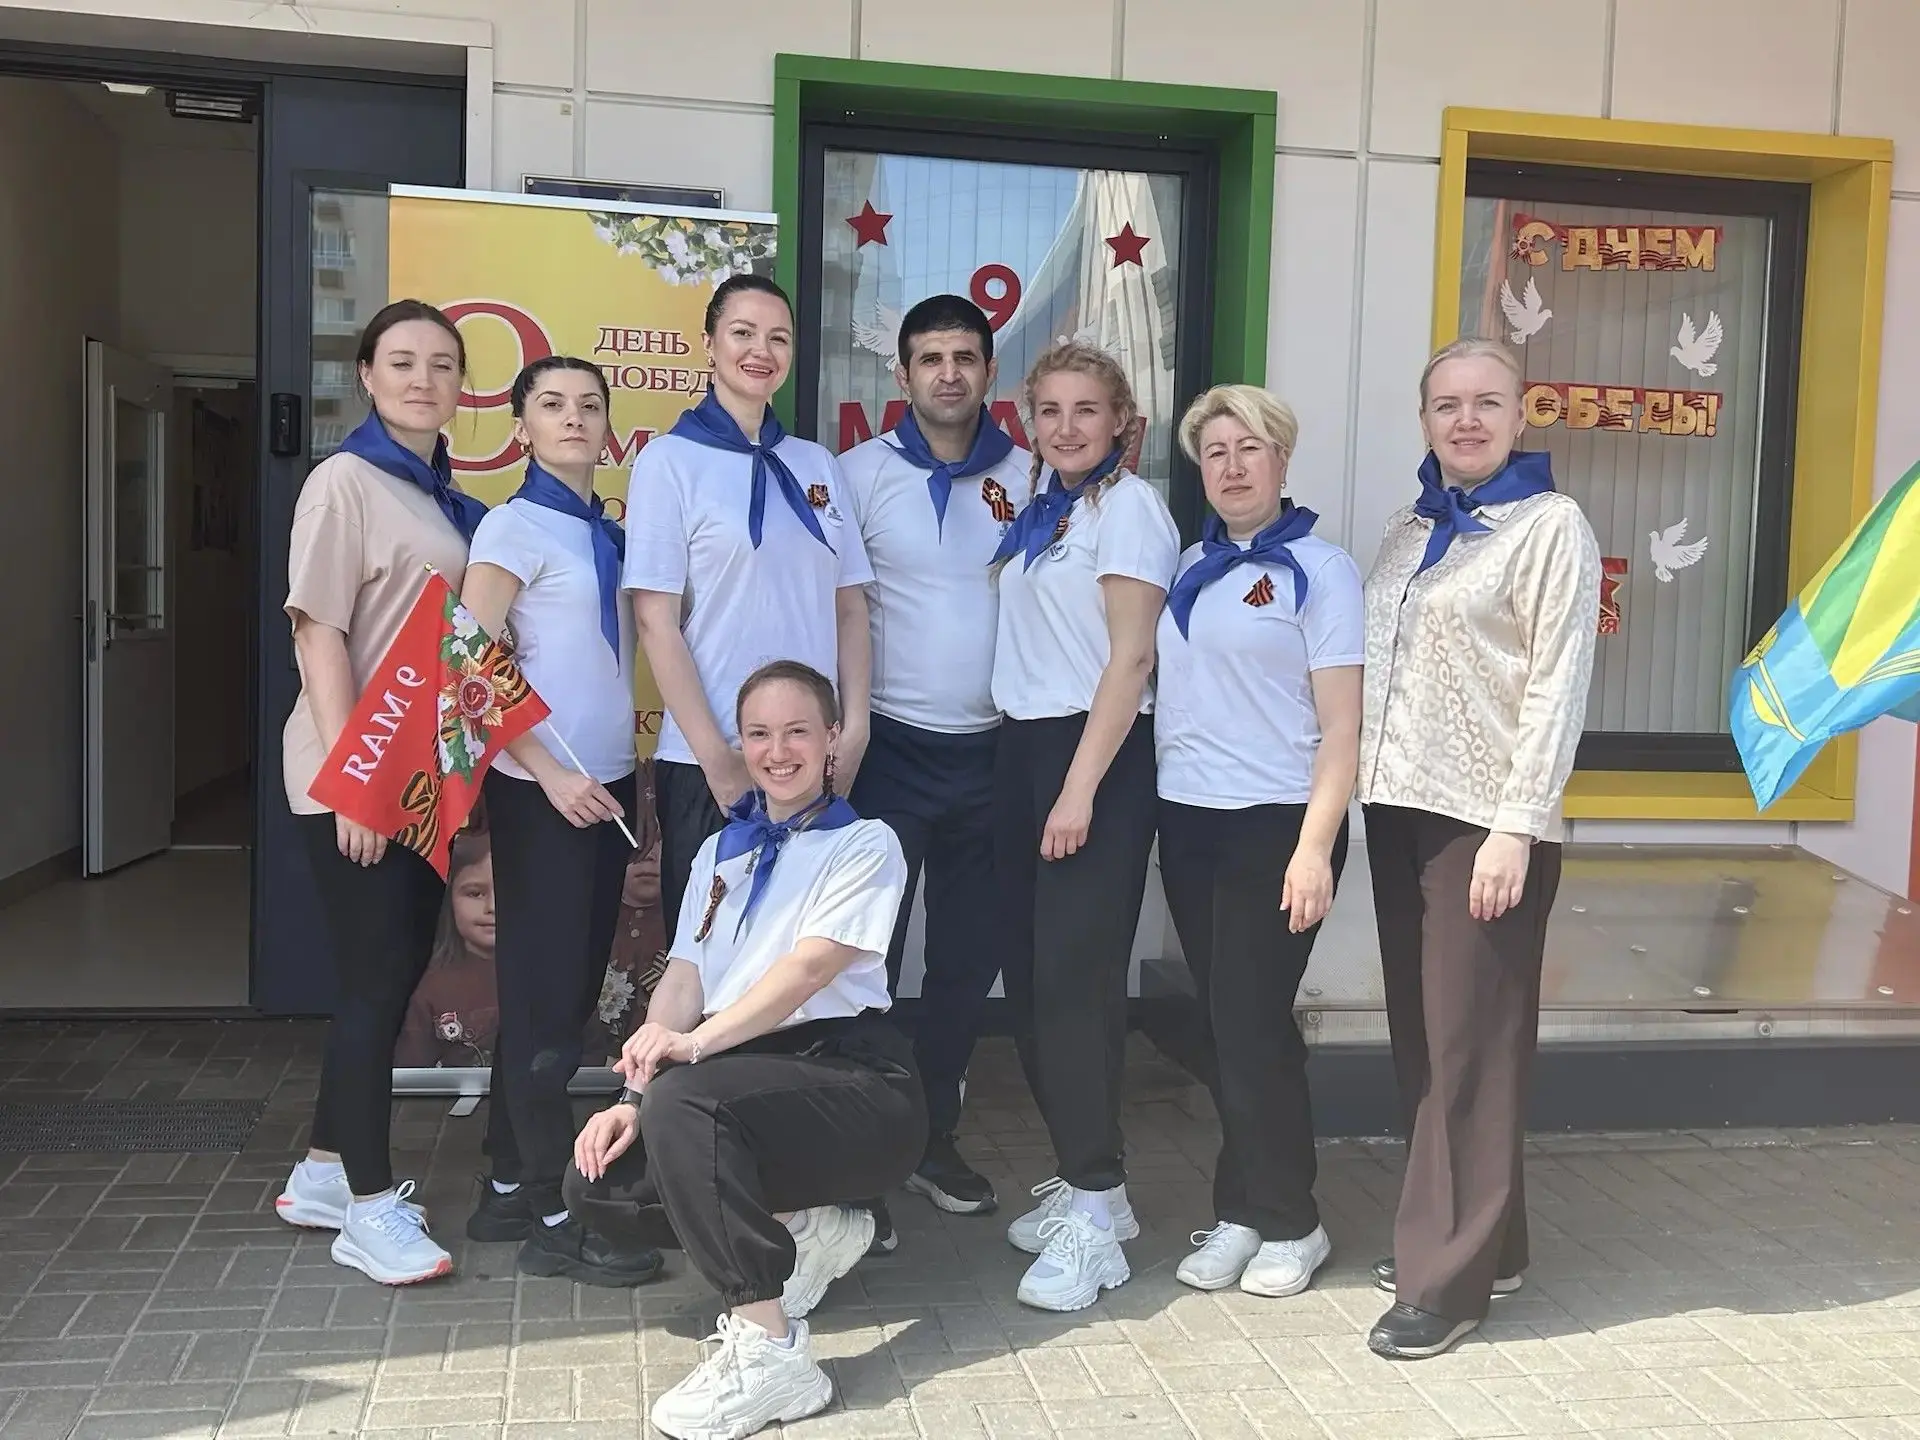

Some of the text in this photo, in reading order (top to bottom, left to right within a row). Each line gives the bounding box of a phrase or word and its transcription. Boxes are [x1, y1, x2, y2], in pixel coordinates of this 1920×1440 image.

[1514, 221, 1718, 272] С ДНЕМ
[970, 264, 1022, 334] 9
[594, 327, 690, 355] ДЕНЬ
[438, 300, 553, 474] 9
[599, 365, 715, 397] ПОБЕД
[1523, 385, 1718, 437] ОБЕДЫ!
